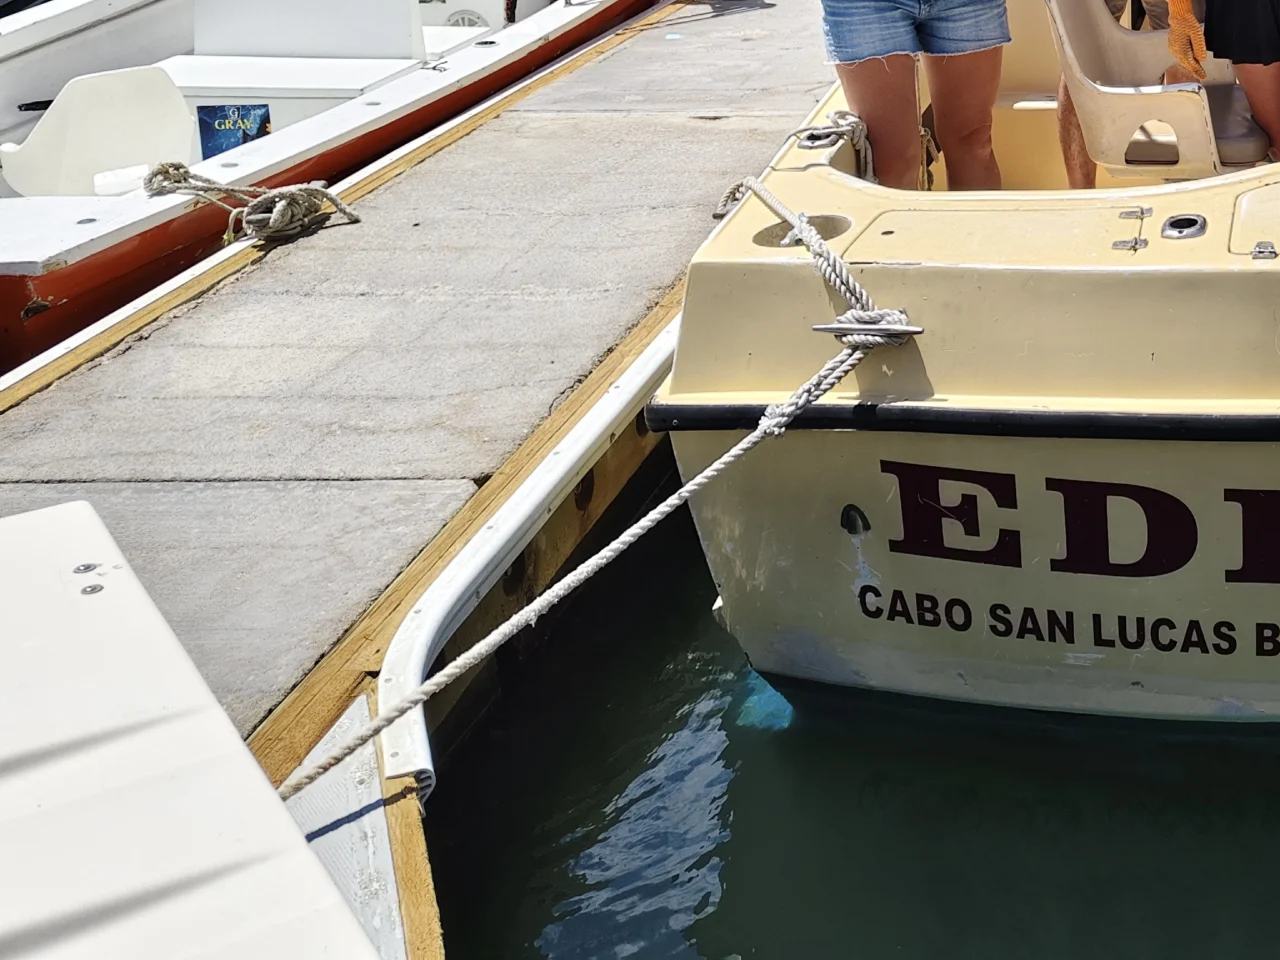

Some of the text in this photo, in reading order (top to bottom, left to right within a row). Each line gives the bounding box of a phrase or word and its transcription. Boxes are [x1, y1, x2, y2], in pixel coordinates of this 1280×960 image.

[214, 119, 252, 131] GRAY
[858, 584, 973, 632] CABO
[988, 602, 1076, 645] SAN
[1091, 613, 1238, 657] LUCAS
